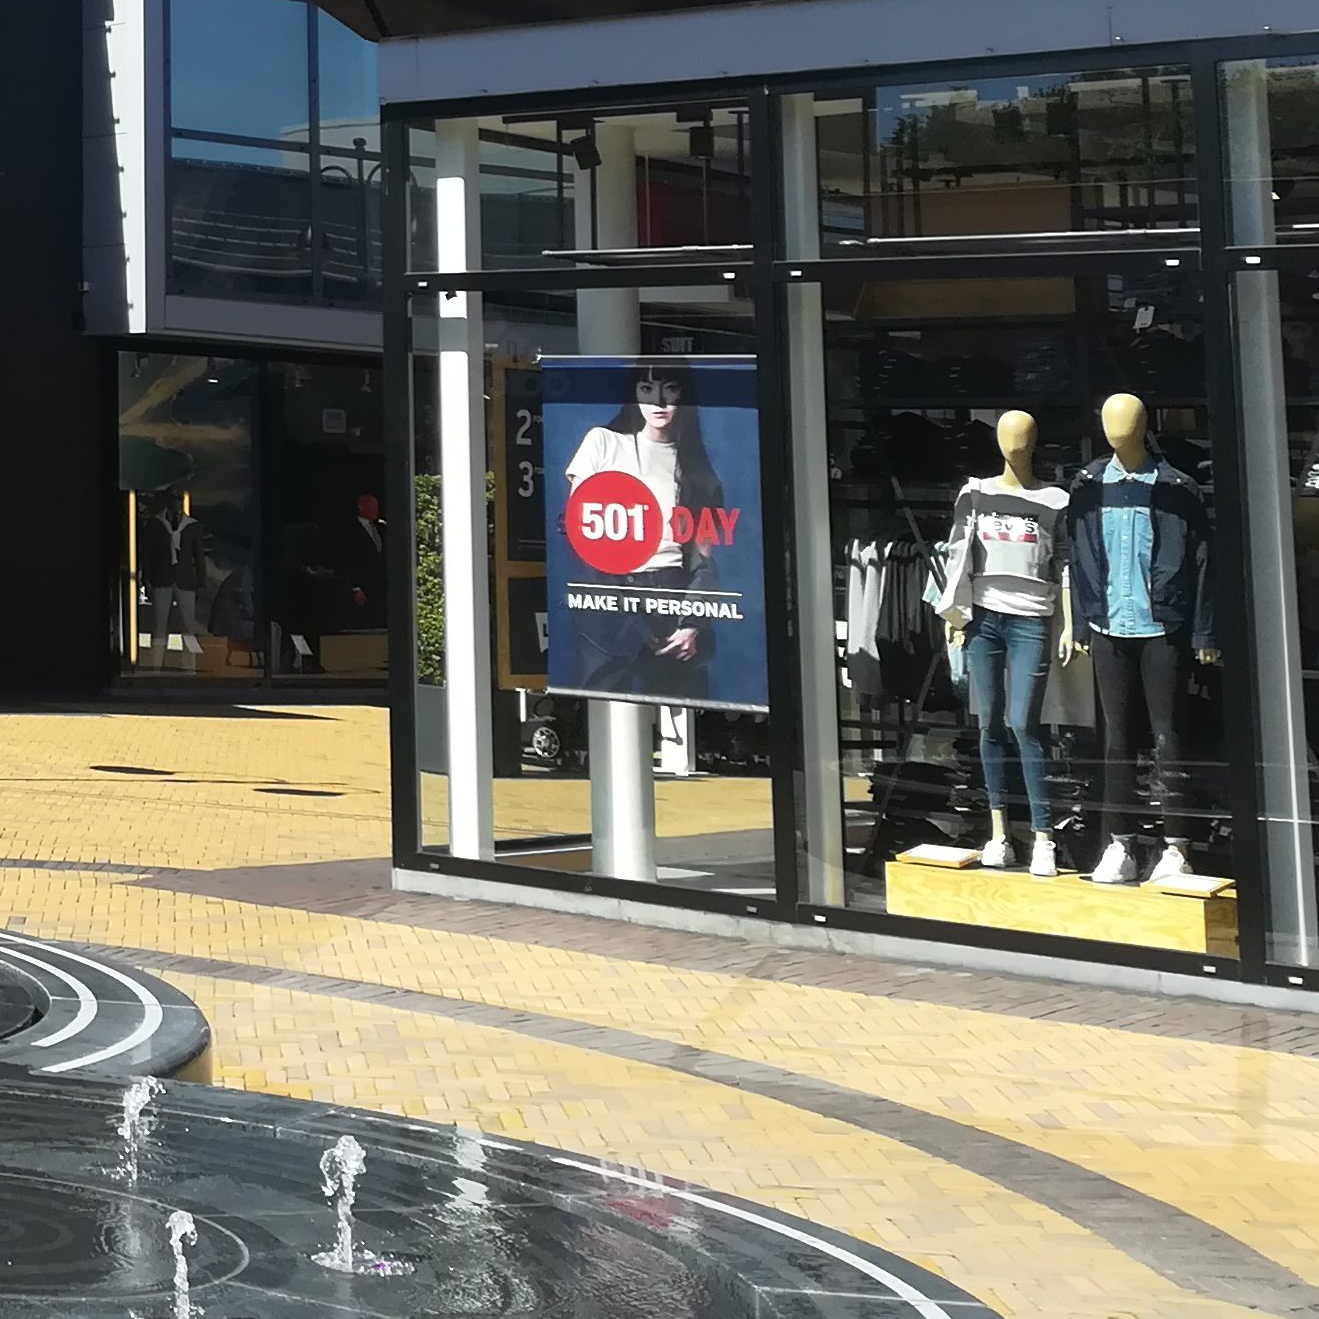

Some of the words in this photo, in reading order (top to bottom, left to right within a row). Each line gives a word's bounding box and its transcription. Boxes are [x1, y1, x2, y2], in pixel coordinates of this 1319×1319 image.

[672, 507, 740, 547] DAY
[567, 592, 619, 612] MAKE
[623, 596, 641, 613] IT
[645, 598, 744, 620] PERSONAL
